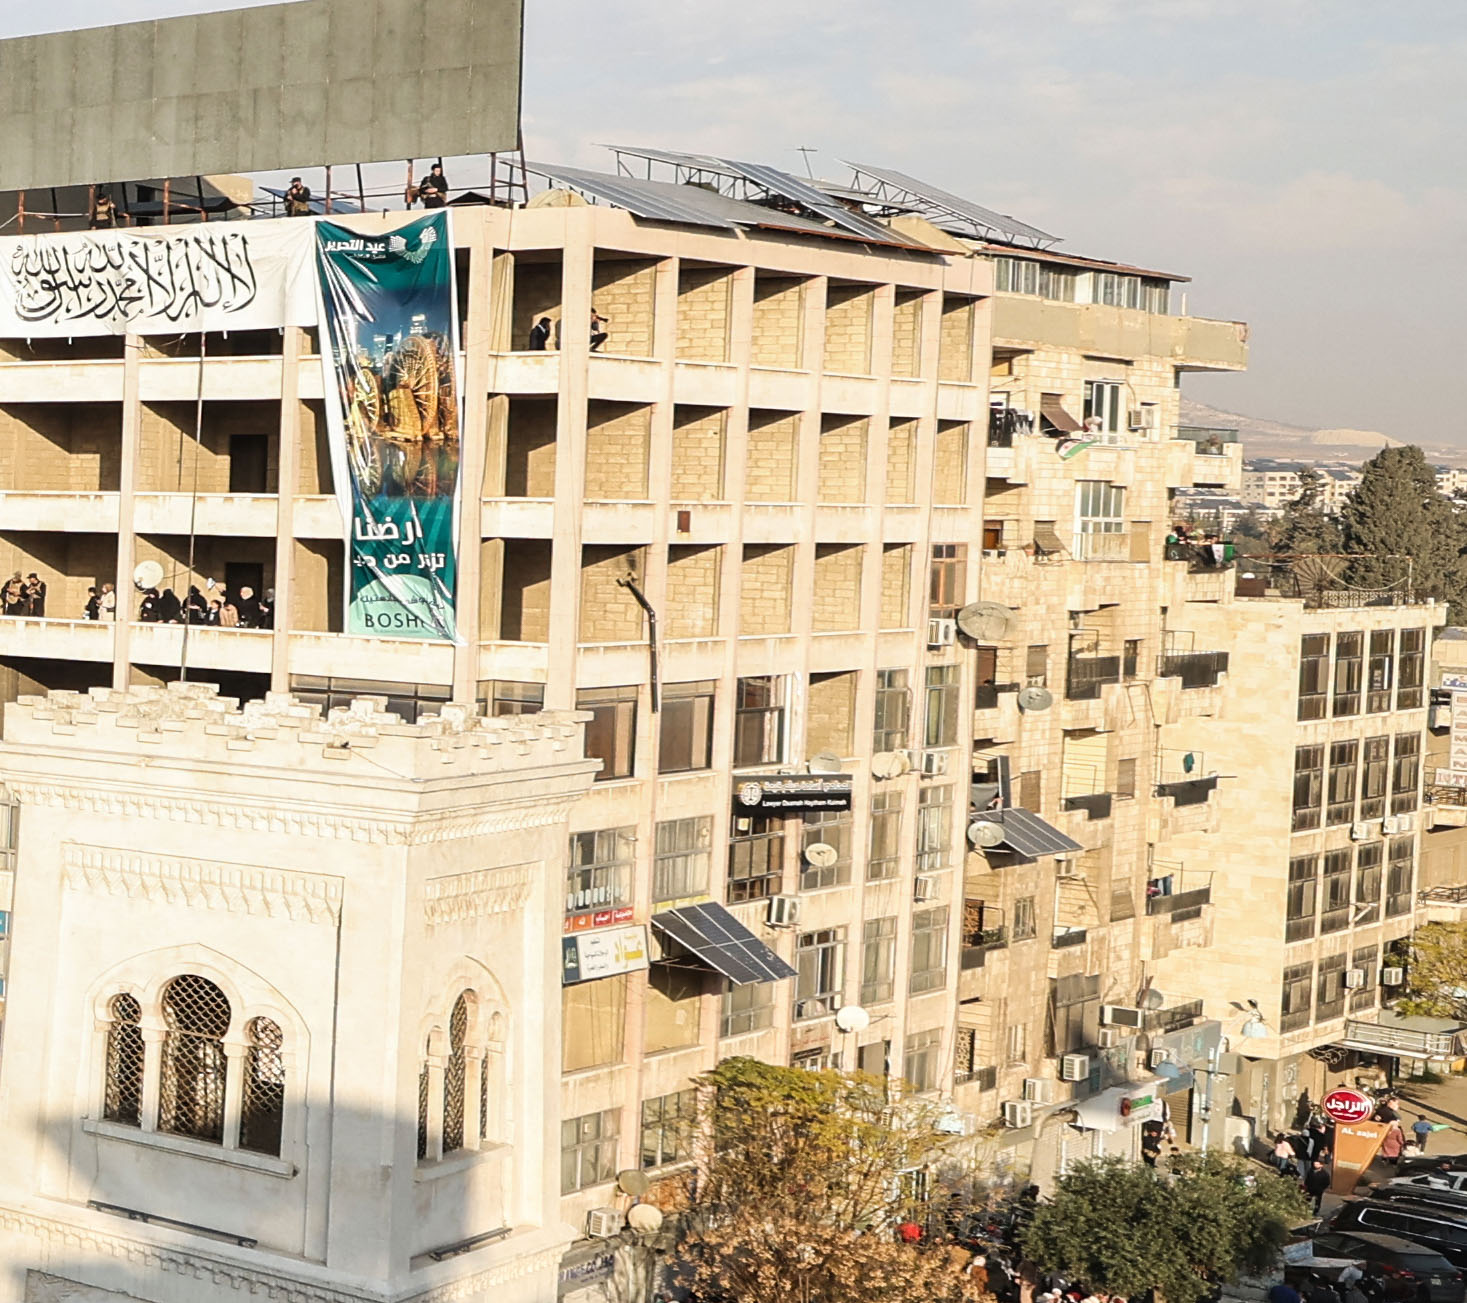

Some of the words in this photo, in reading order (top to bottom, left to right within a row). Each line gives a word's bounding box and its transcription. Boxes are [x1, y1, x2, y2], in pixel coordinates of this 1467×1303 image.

[325, 239, 364, 252] التحرير
[365, 242, 386, 253] عيد
[383, 553, 411, 568] من
